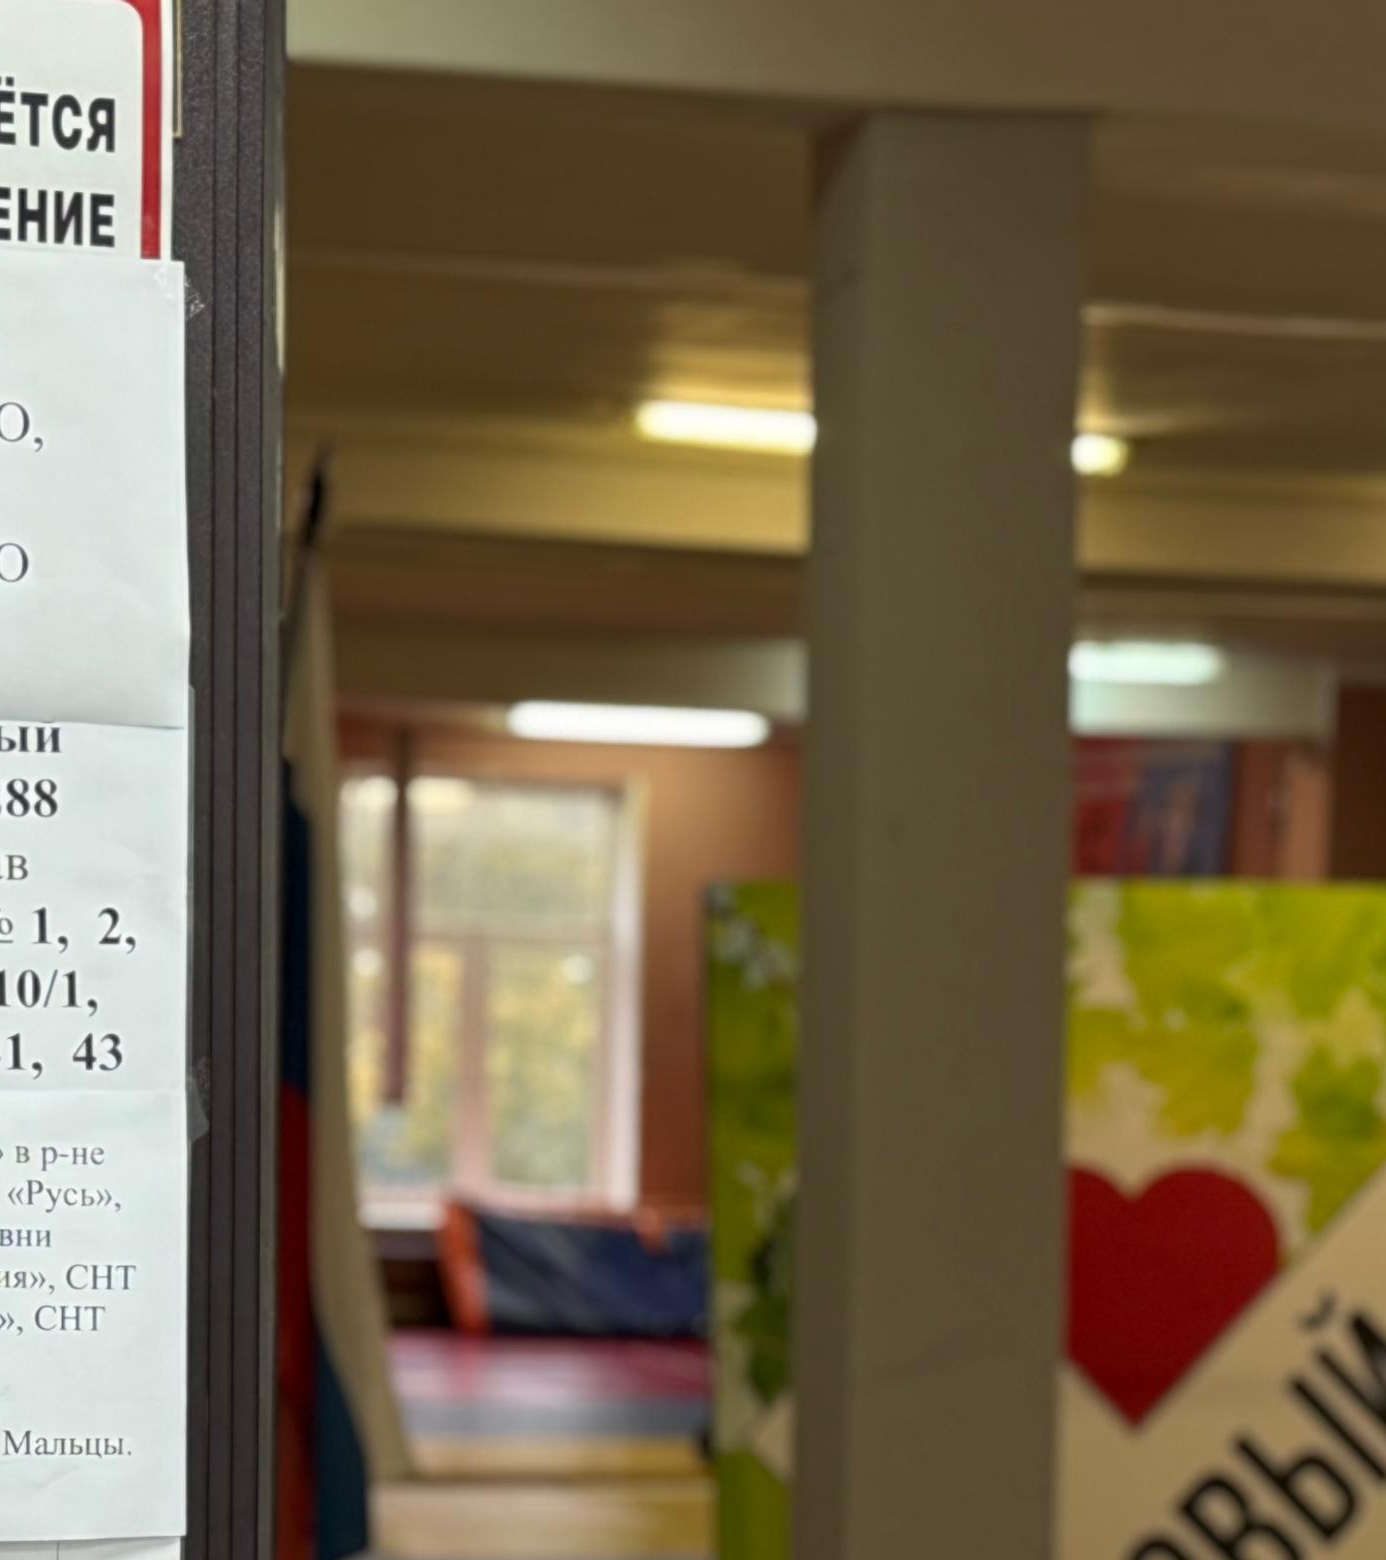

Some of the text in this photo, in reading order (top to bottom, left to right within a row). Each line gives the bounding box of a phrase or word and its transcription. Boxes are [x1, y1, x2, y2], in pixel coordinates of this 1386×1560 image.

[32, 907, 70, 953] 1,
[98, 908, 137, 953] 2,
[72, 1033, 124, 1072] 43
[15, 1145, 31, 1164] в
[40, 1145, 105, 1171] р-не
[8, 1180, 122, 1211] «Русь»,
[66, 1264, 136, 1291] СНТ
[34, 1305, 106, 1332] СНТ
[3, 1429, 131, 1459] Мальцы.
